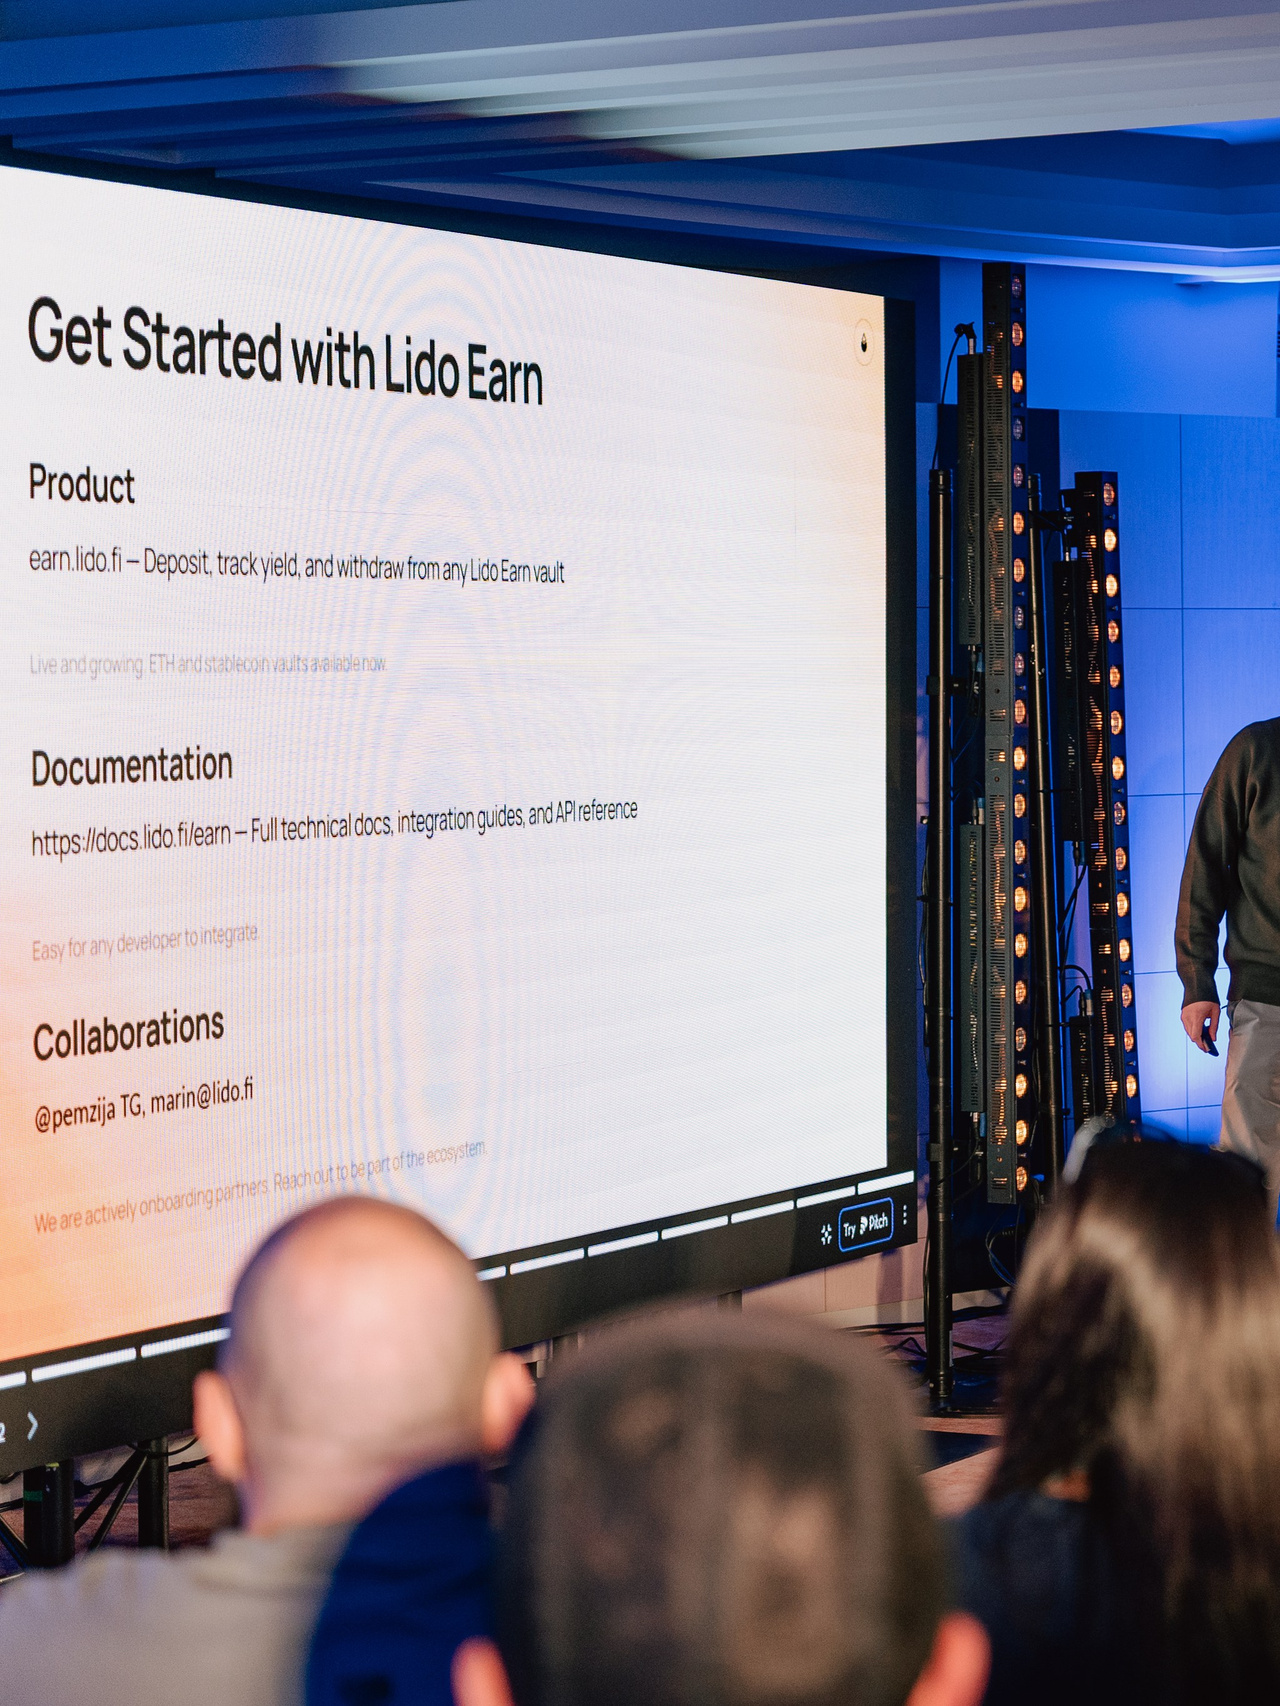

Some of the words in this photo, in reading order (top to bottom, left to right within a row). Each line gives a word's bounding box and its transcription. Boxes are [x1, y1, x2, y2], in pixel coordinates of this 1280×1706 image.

[28, 295, 113, 368] Get
[122, 304, 283, 383] Started
[291, 324, 376, 390] with
[384, 332, 461, 399] Lido
[468, 342, 543, 405] Earn
[29, 462, 136, 504] Product
[28, 545, 123, 573] earn.lido.fi
[144, 547, 213, 582] Deposit,
[216, 550, 259, 577] track
[260, 551, 301, 584] yield,
[304, 553, 334, 579] and
[336, 553, 405, 581] withdraw
[407, 555, 440, 581] from
[442, 560, 469, 588] any
[470, 557, 499, 583] Lido
[501, 559, 532, 584] Earn
[533, 560, 566, 585] vault
[29, 654, 58, 675] Live
[60, 654, 87, 675] and
[149, 654, 176, 674] ETH
[178, 653, 203, 674] and
[204, 653, 270, 674] stablecoin
[272, 653, 308, 673] vaults
[309, 653, 361, 673] available
[31, 746, 233, 787] Documentation
[31, 822, 232, 863] https://docs.lido.fi/earn
[251, 817, 278, 843] Full
[280, 813, 352, 840] technical
[354, 812, 395, 838] docs,
[397, 804, 475, 839] integration
[477, 804, 526, 836] guides,
[528, 801, 554, 826] and
[555, 800, 577, 824] API
[578, 799, 639, 821] reference
[32, 939, 66, 964] Easy
[68, 937, 88, 958] for
[90, 934, 115, 960] any
[116, 930, 183, 956] developer
[184, 927, 200, 948] to
[33, 1008, 225, 1061] Collaborations
[34, 1096, 117, 1134] @pemzija
[119, 1092, 148, 1119] TG,
[150, 1075, 255, 1111] marin@lido.fi
[34, 1213, 58, 1234] We
[59, 1210, 84, 1231] are
[84, 1198, 138, 1226] actively
[139, 1186, 214, 1212] onboarding
[273, 1169, 312, 1192] Reach
[313, 1165, 335, 1184] out
[336, 1163, 350, 1182] to
[350, 1160, 366, 1179] be
[367, 1156, 392, 1180] part
[392, 1153, 406, 1172] of
[406, 1149, 426, 1167] the
[842, 1221, 857, 1240] Try
[868, 1211, 889, 1232] Pitch
